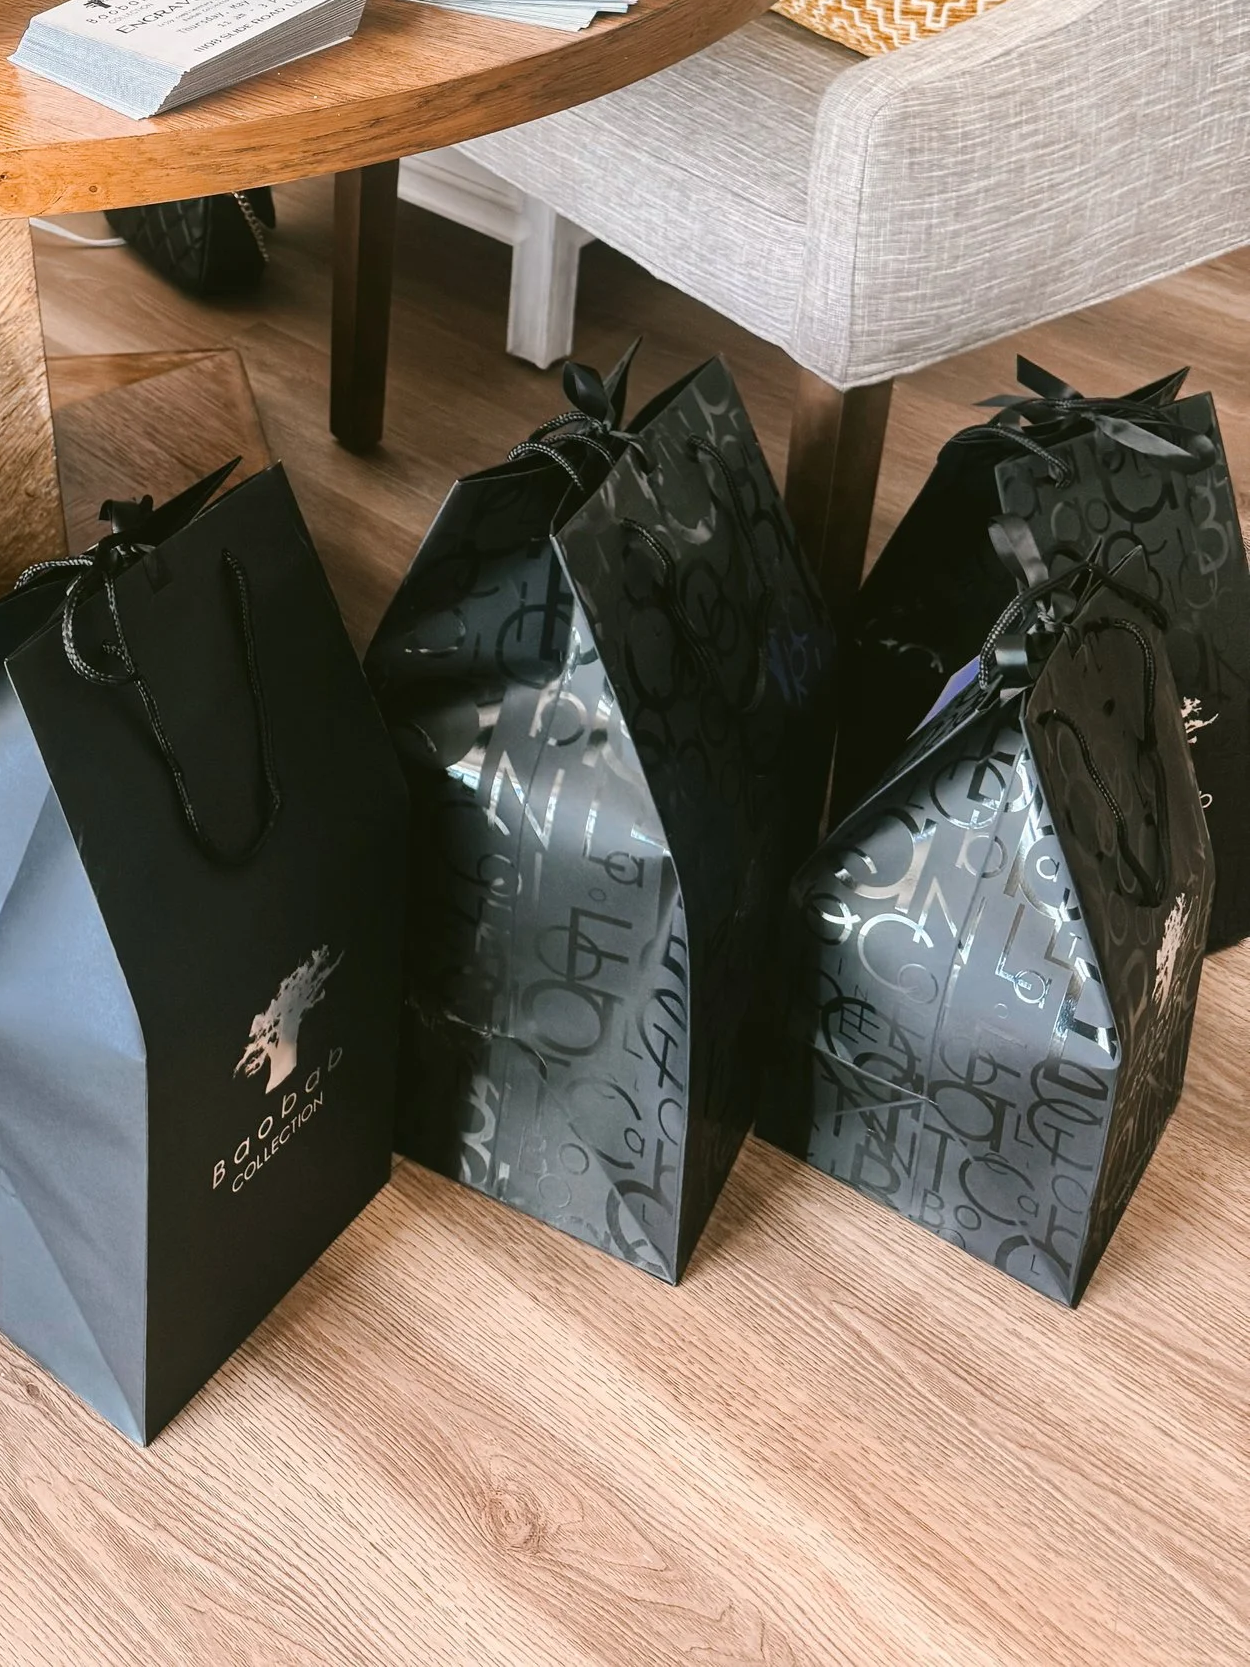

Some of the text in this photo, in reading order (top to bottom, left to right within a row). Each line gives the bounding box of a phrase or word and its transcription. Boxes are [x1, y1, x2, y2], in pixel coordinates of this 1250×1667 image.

[177, 11, 229, 34] Thursday,
[229, 0, 249, 10] May
[212, 1047, 343, 1190] Baobab
[232, 1091, 324, 1193] COLLECTION
